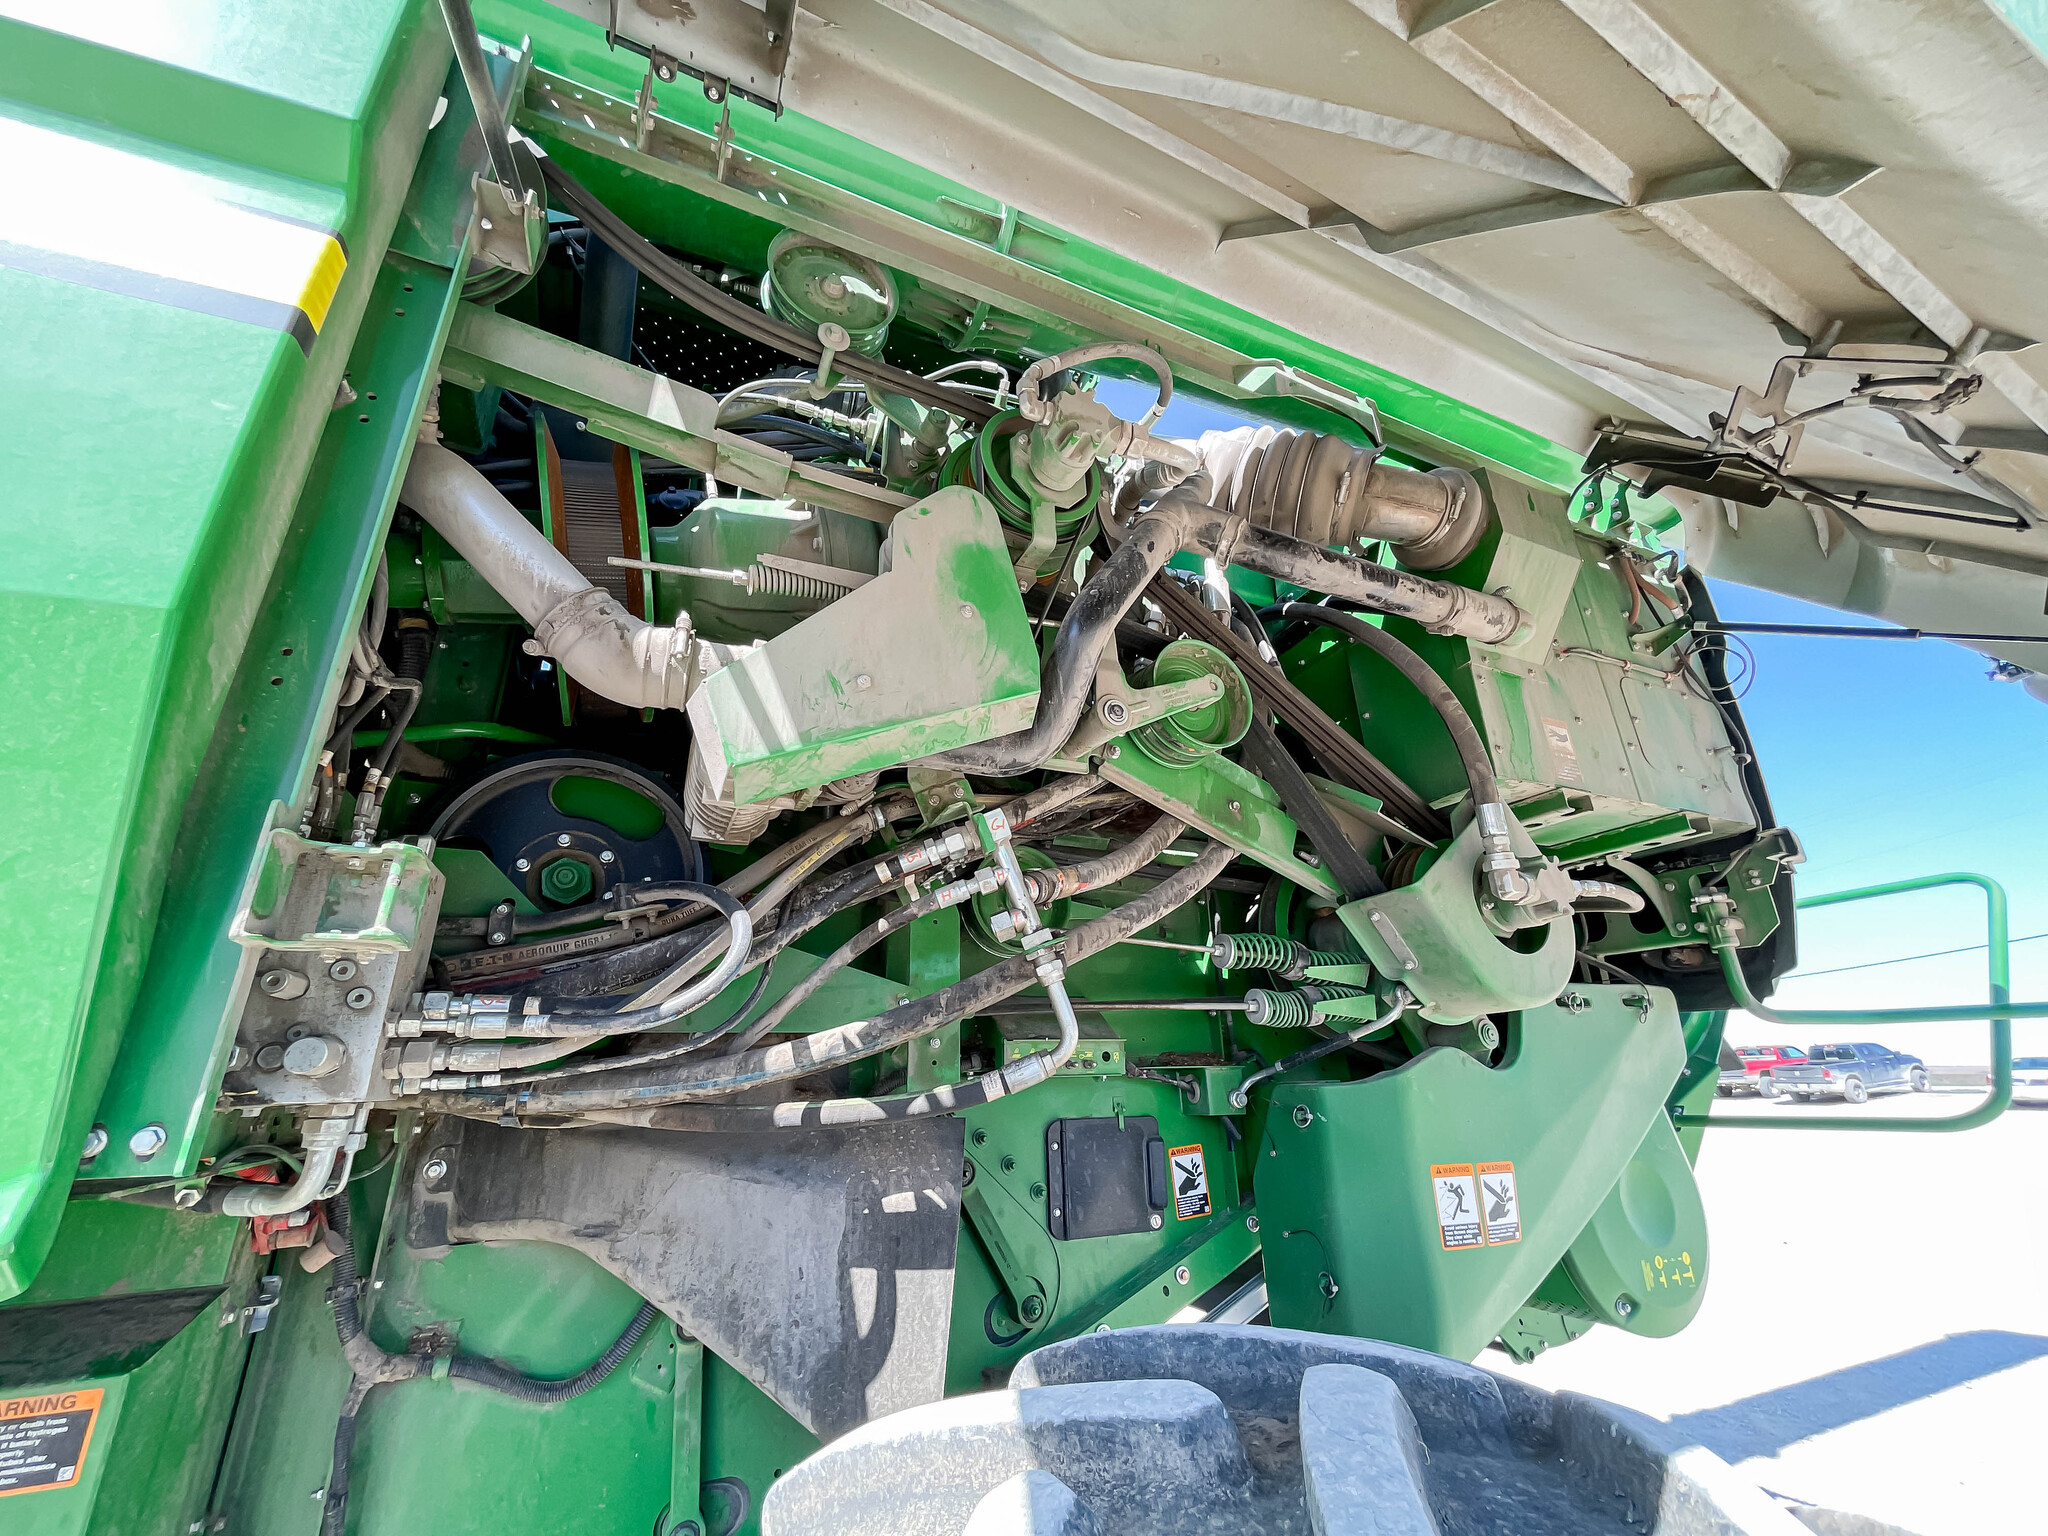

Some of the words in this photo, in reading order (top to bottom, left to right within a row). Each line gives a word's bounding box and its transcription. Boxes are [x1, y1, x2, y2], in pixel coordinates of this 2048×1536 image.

[940, 889, 953, 903] H
[1176, 1145, 1201, 1154] WARNING
[1442, 1166, 1470, 1174] WARNING
[46, 1418, 67, 1427] from
[27, 1426, 69, 1438] hydrogen
